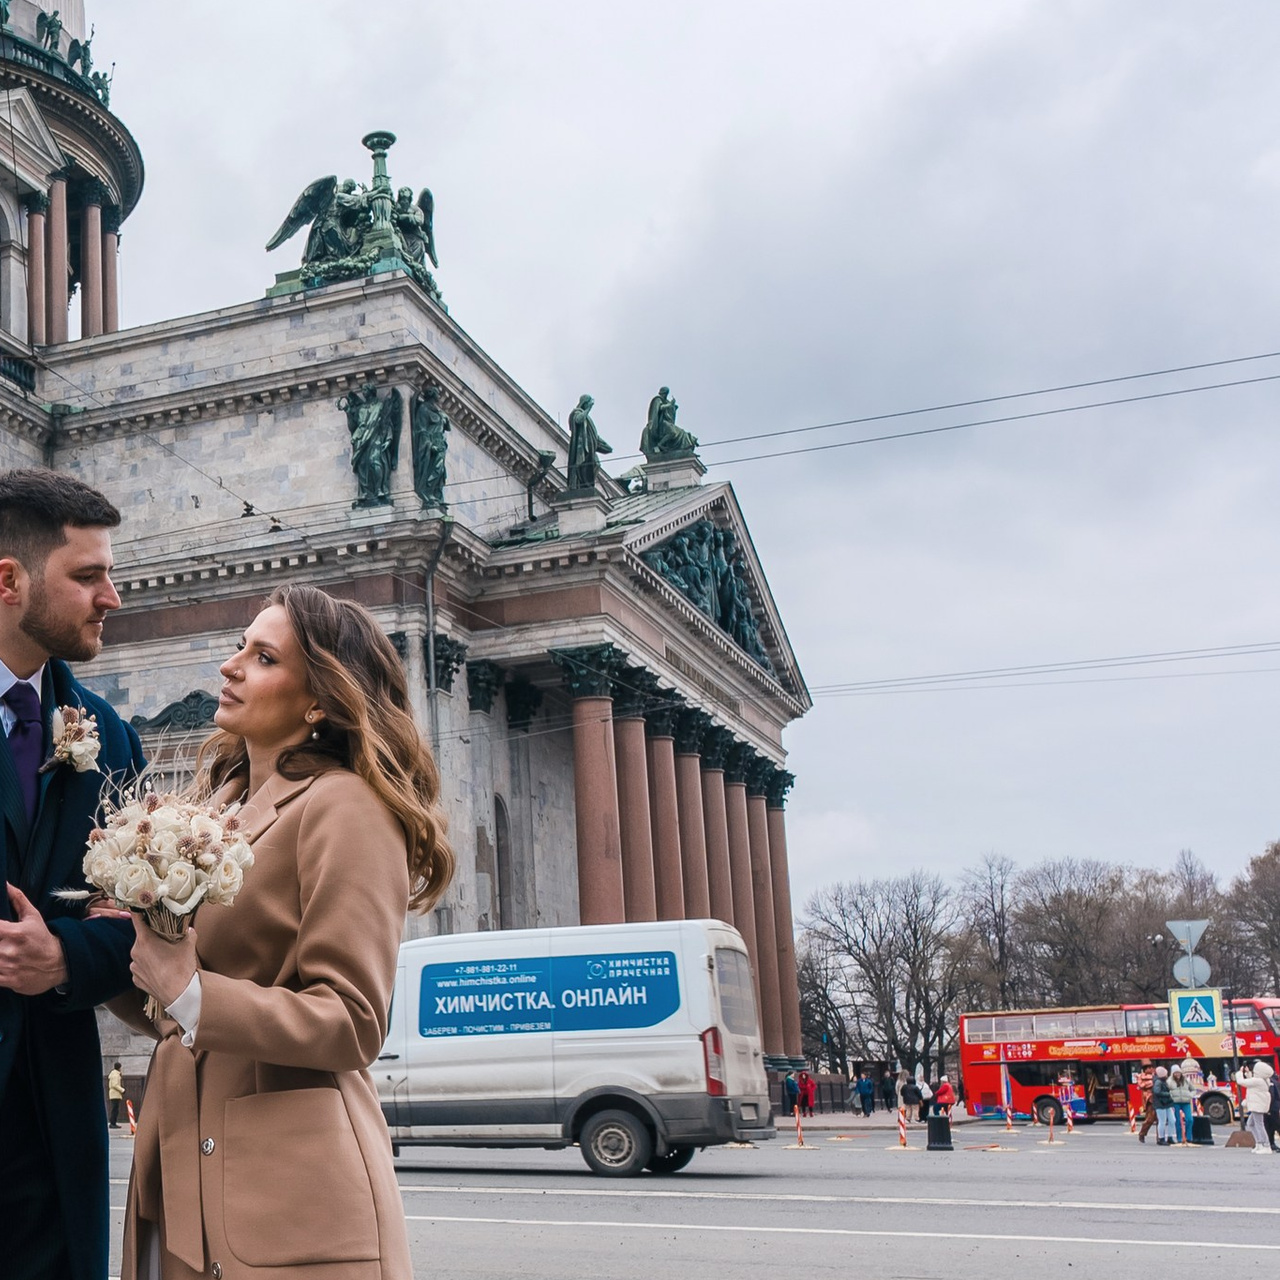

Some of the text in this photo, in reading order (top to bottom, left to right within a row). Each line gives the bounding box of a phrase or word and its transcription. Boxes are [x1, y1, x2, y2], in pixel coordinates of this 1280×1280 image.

[608, 957, 670, 968] ХИМЧИСТКА
[608, 967, 671, 978] ПРАЧЕЧНАЯ
[436, 974, 537, 988] www.himchistka.online
[561, 982, 648, 1008] ОНЛАЙН
[423, 1026, 458, 1036] ЗАБЕРЕМ
[463, 1024, 504, 1034] ПОЧИСТИМ
[510, 1022, 551, 1031] ПРИВЕЗЕМ
